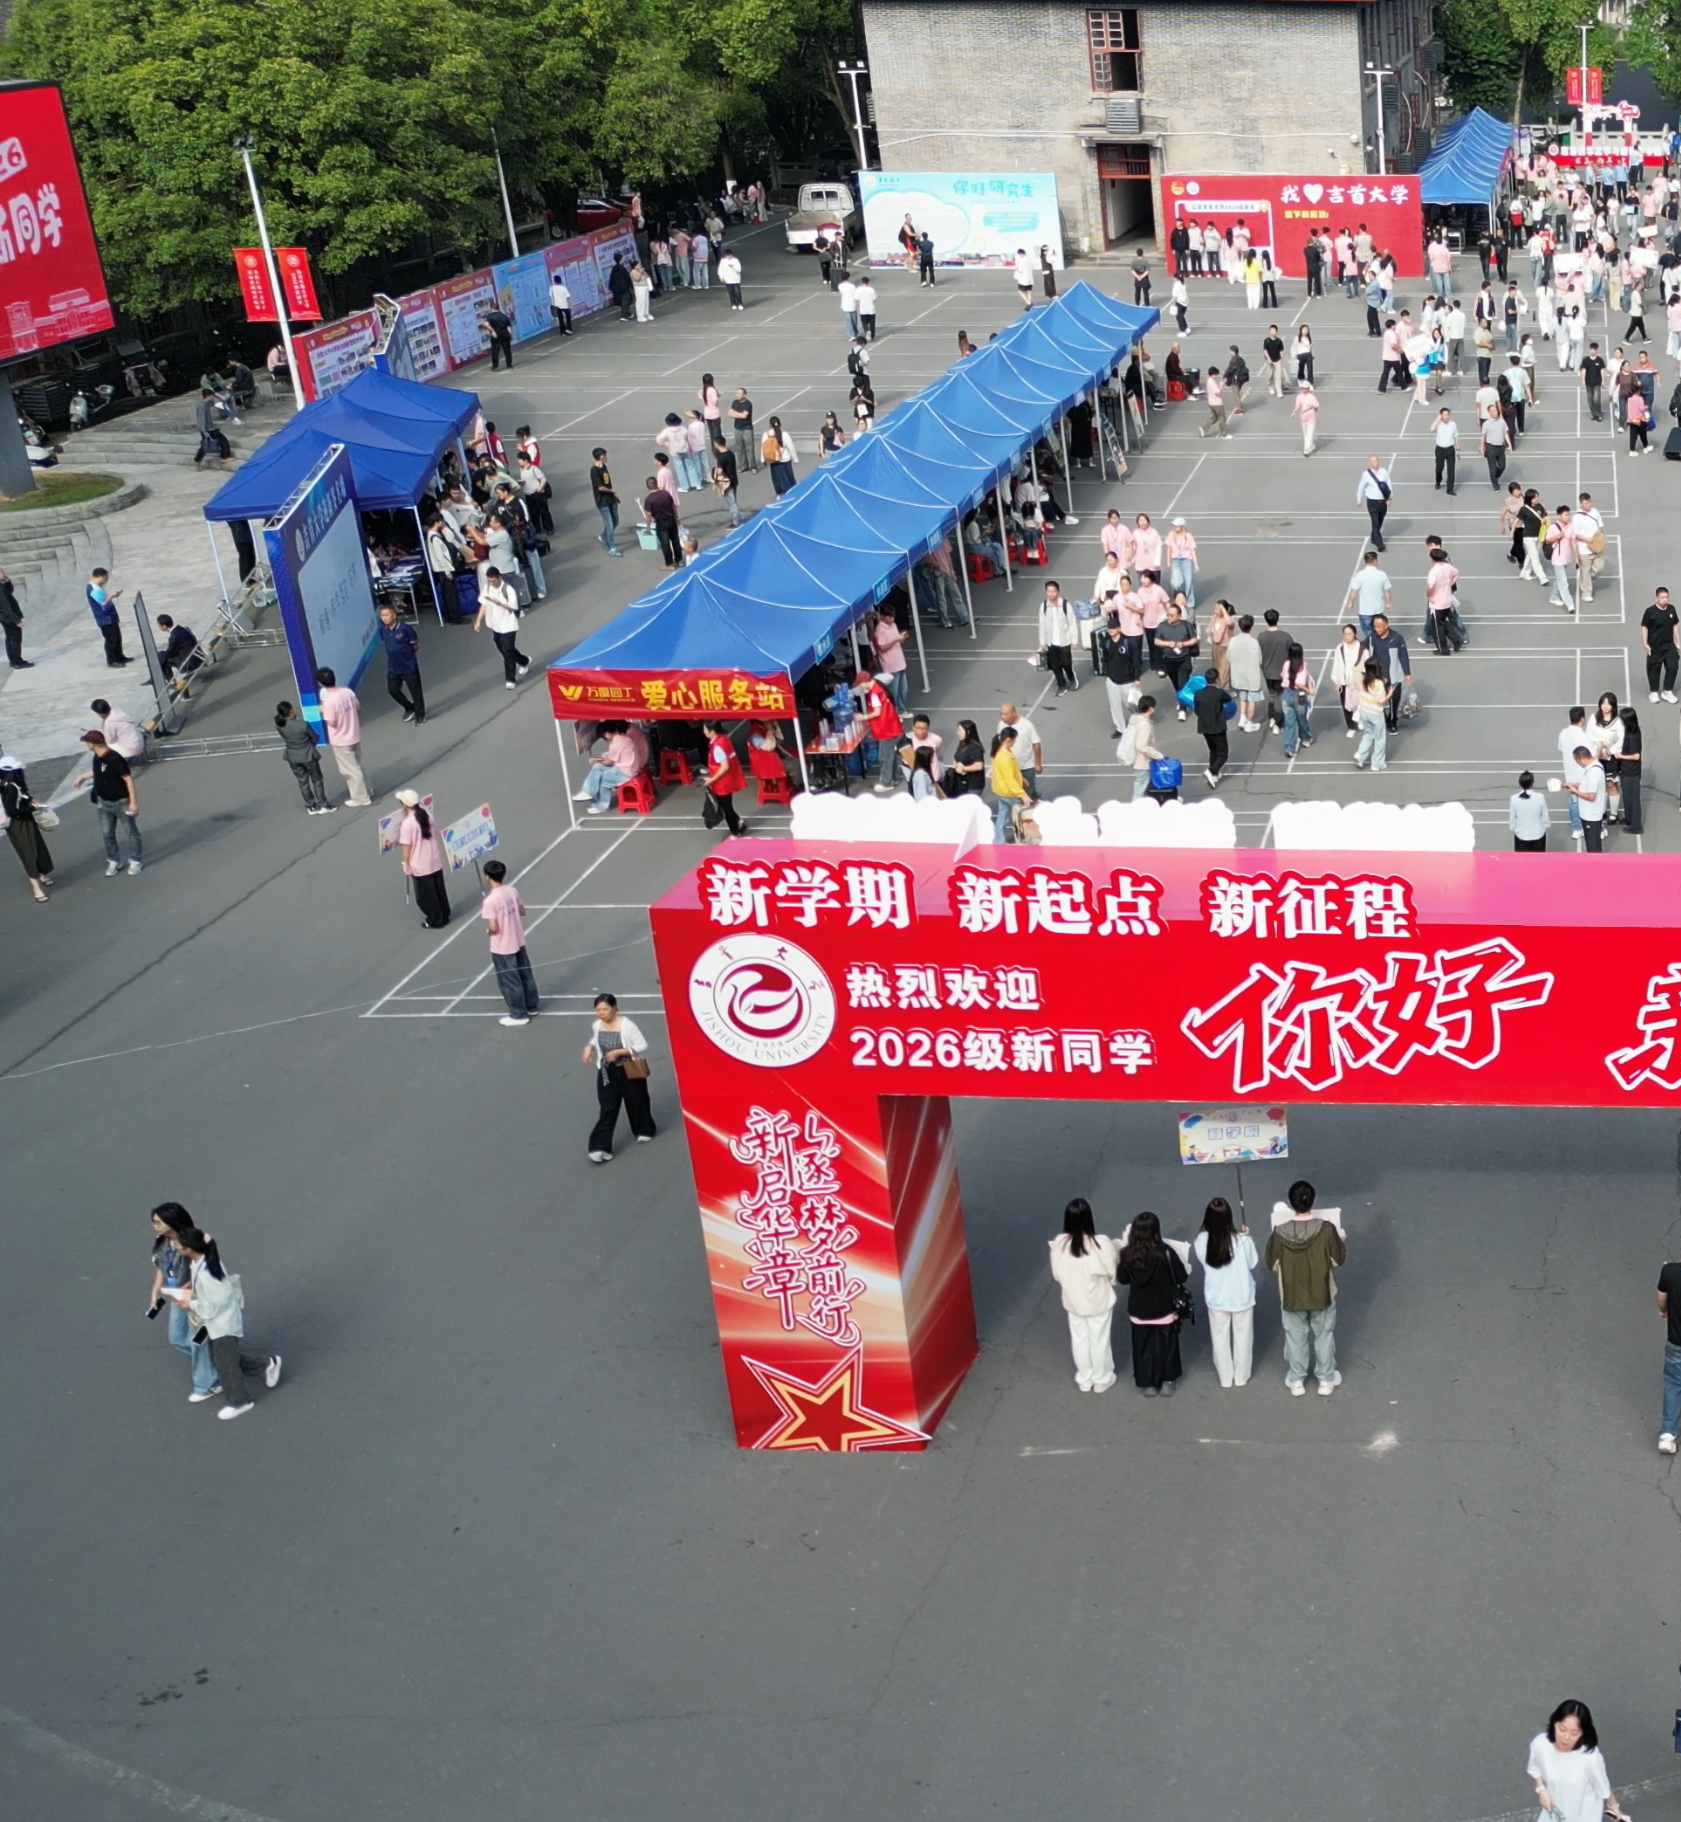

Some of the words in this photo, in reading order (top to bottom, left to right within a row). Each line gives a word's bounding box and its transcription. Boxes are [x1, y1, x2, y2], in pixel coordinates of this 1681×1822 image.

[953, 180, 1034, 198] 你好研究生
[1281, 185, 1301, 204] 我
[1326, 184, 1409, 205] 吉首大学
[641, 679, 785, 711] 爱心服务站
[706, 868, 912, 928] 新学期
[956, 875, 1163, 937] 新起点
[1208, 878, 1411, 939] 新征程
[846, 963, 1041, 1011] 热烈欢迎
[701, 1010, 747, 1054] JISHOU
[754, 1011, 828, 1060] UNIVERSITY
[1181, 937, 1554, 1094] 你好
[850, 1030, 1153, 1075] 2026级新同学
[729, 1106, 807, 1331] 新启华章
[796, 1110, 866, 1347] 逐梦前行
